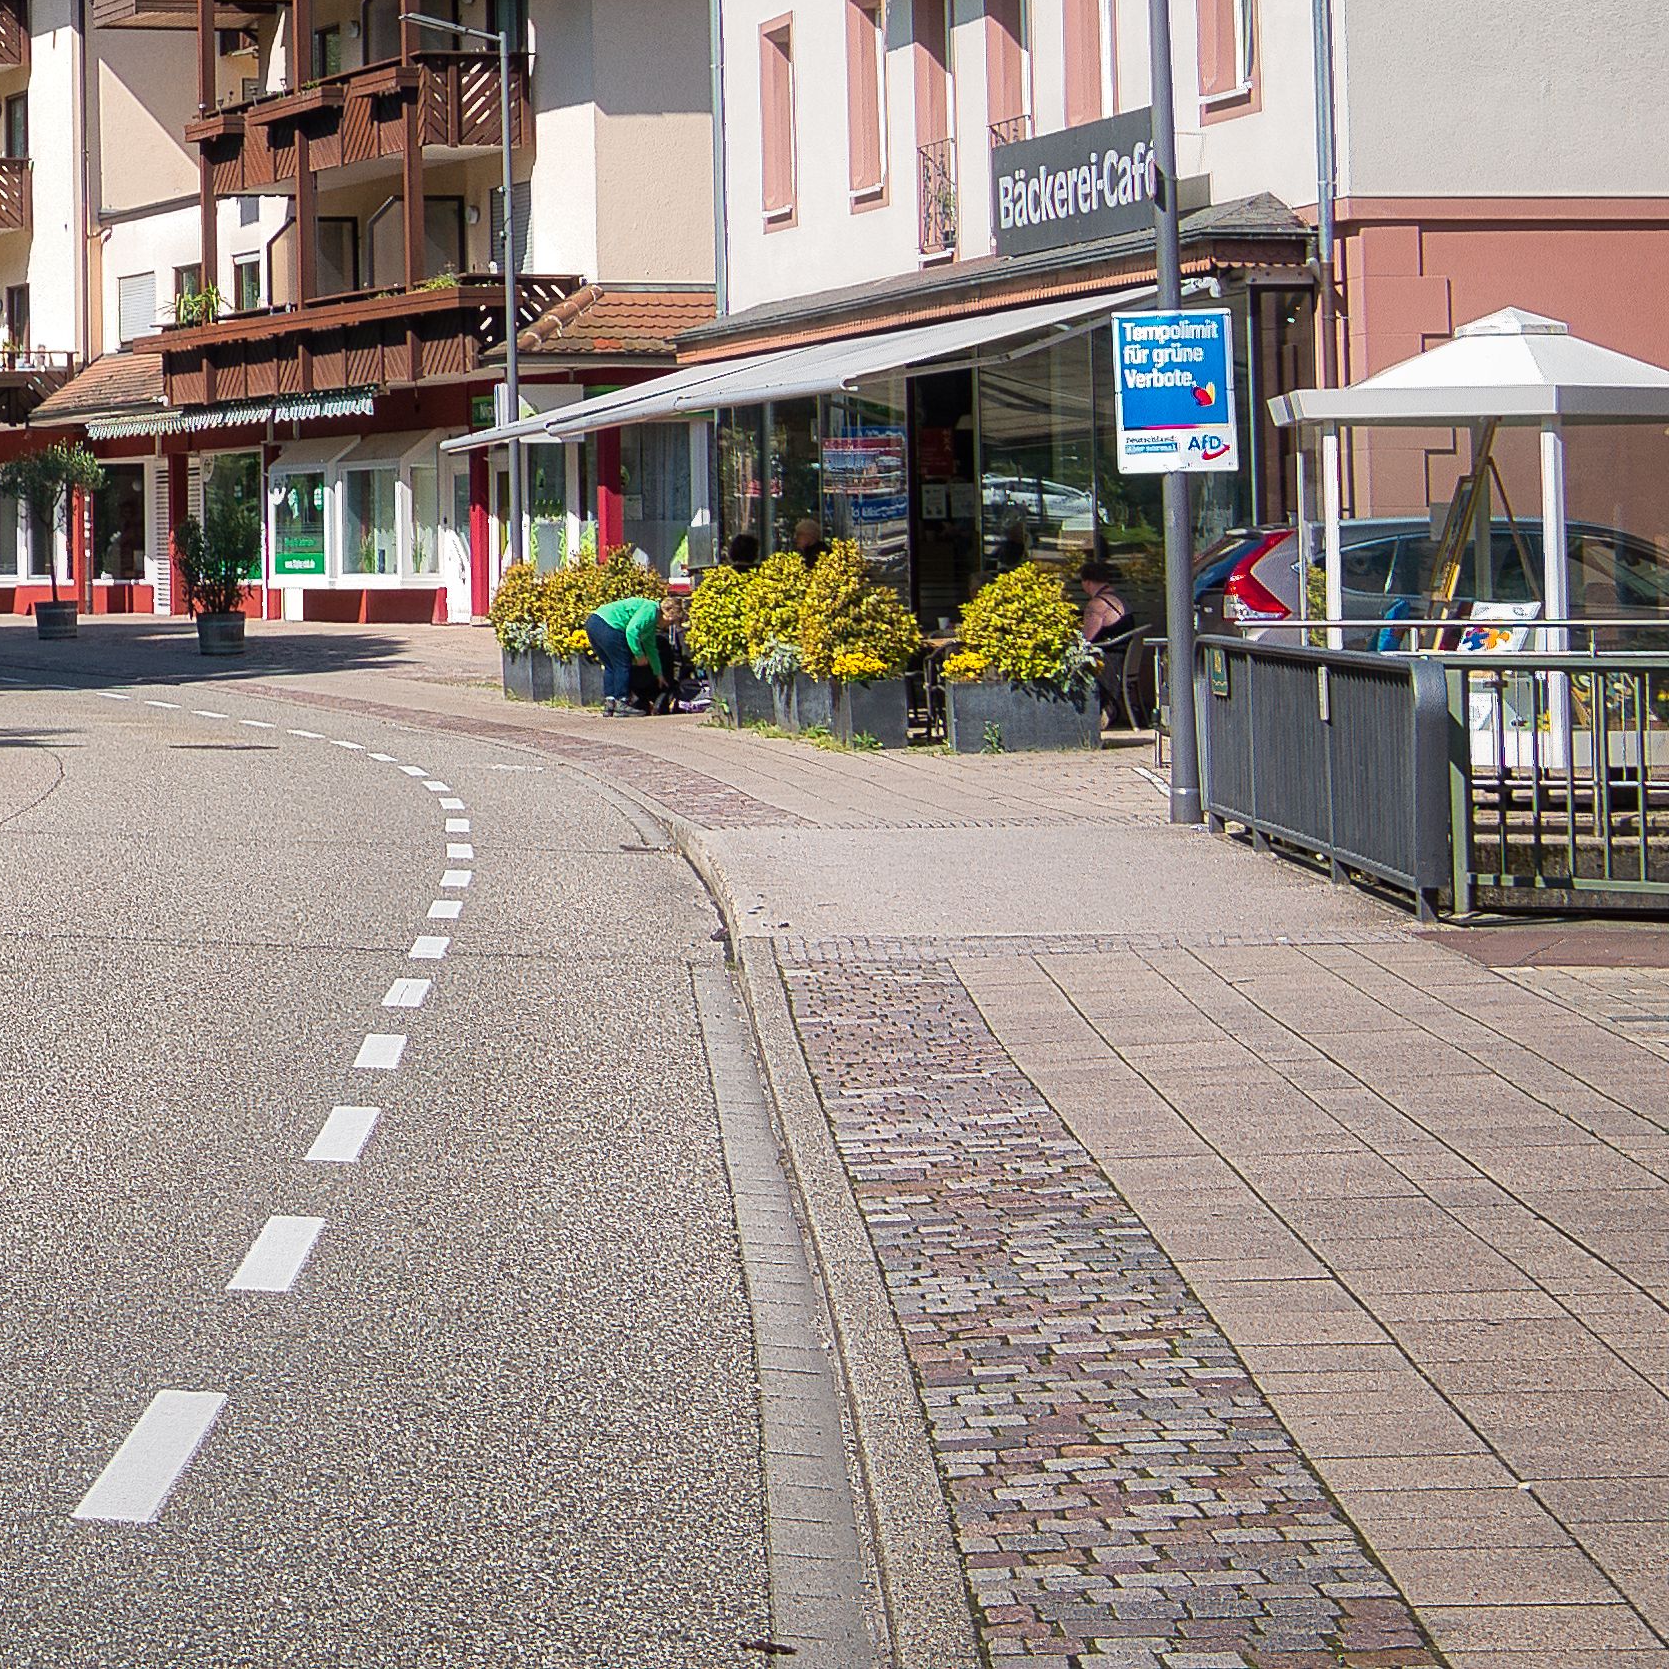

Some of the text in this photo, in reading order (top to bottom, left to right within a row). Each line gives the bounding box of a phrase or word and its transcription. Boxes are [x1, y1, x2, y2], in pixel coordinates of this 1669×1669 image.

[1122, 319, 1218, 344] Tempolimit
[1123, 343, 1203, 368] für grüne
[1123, 369, 1198, 389] Verbote.
[1188, 434, 1221, 451] AfD
